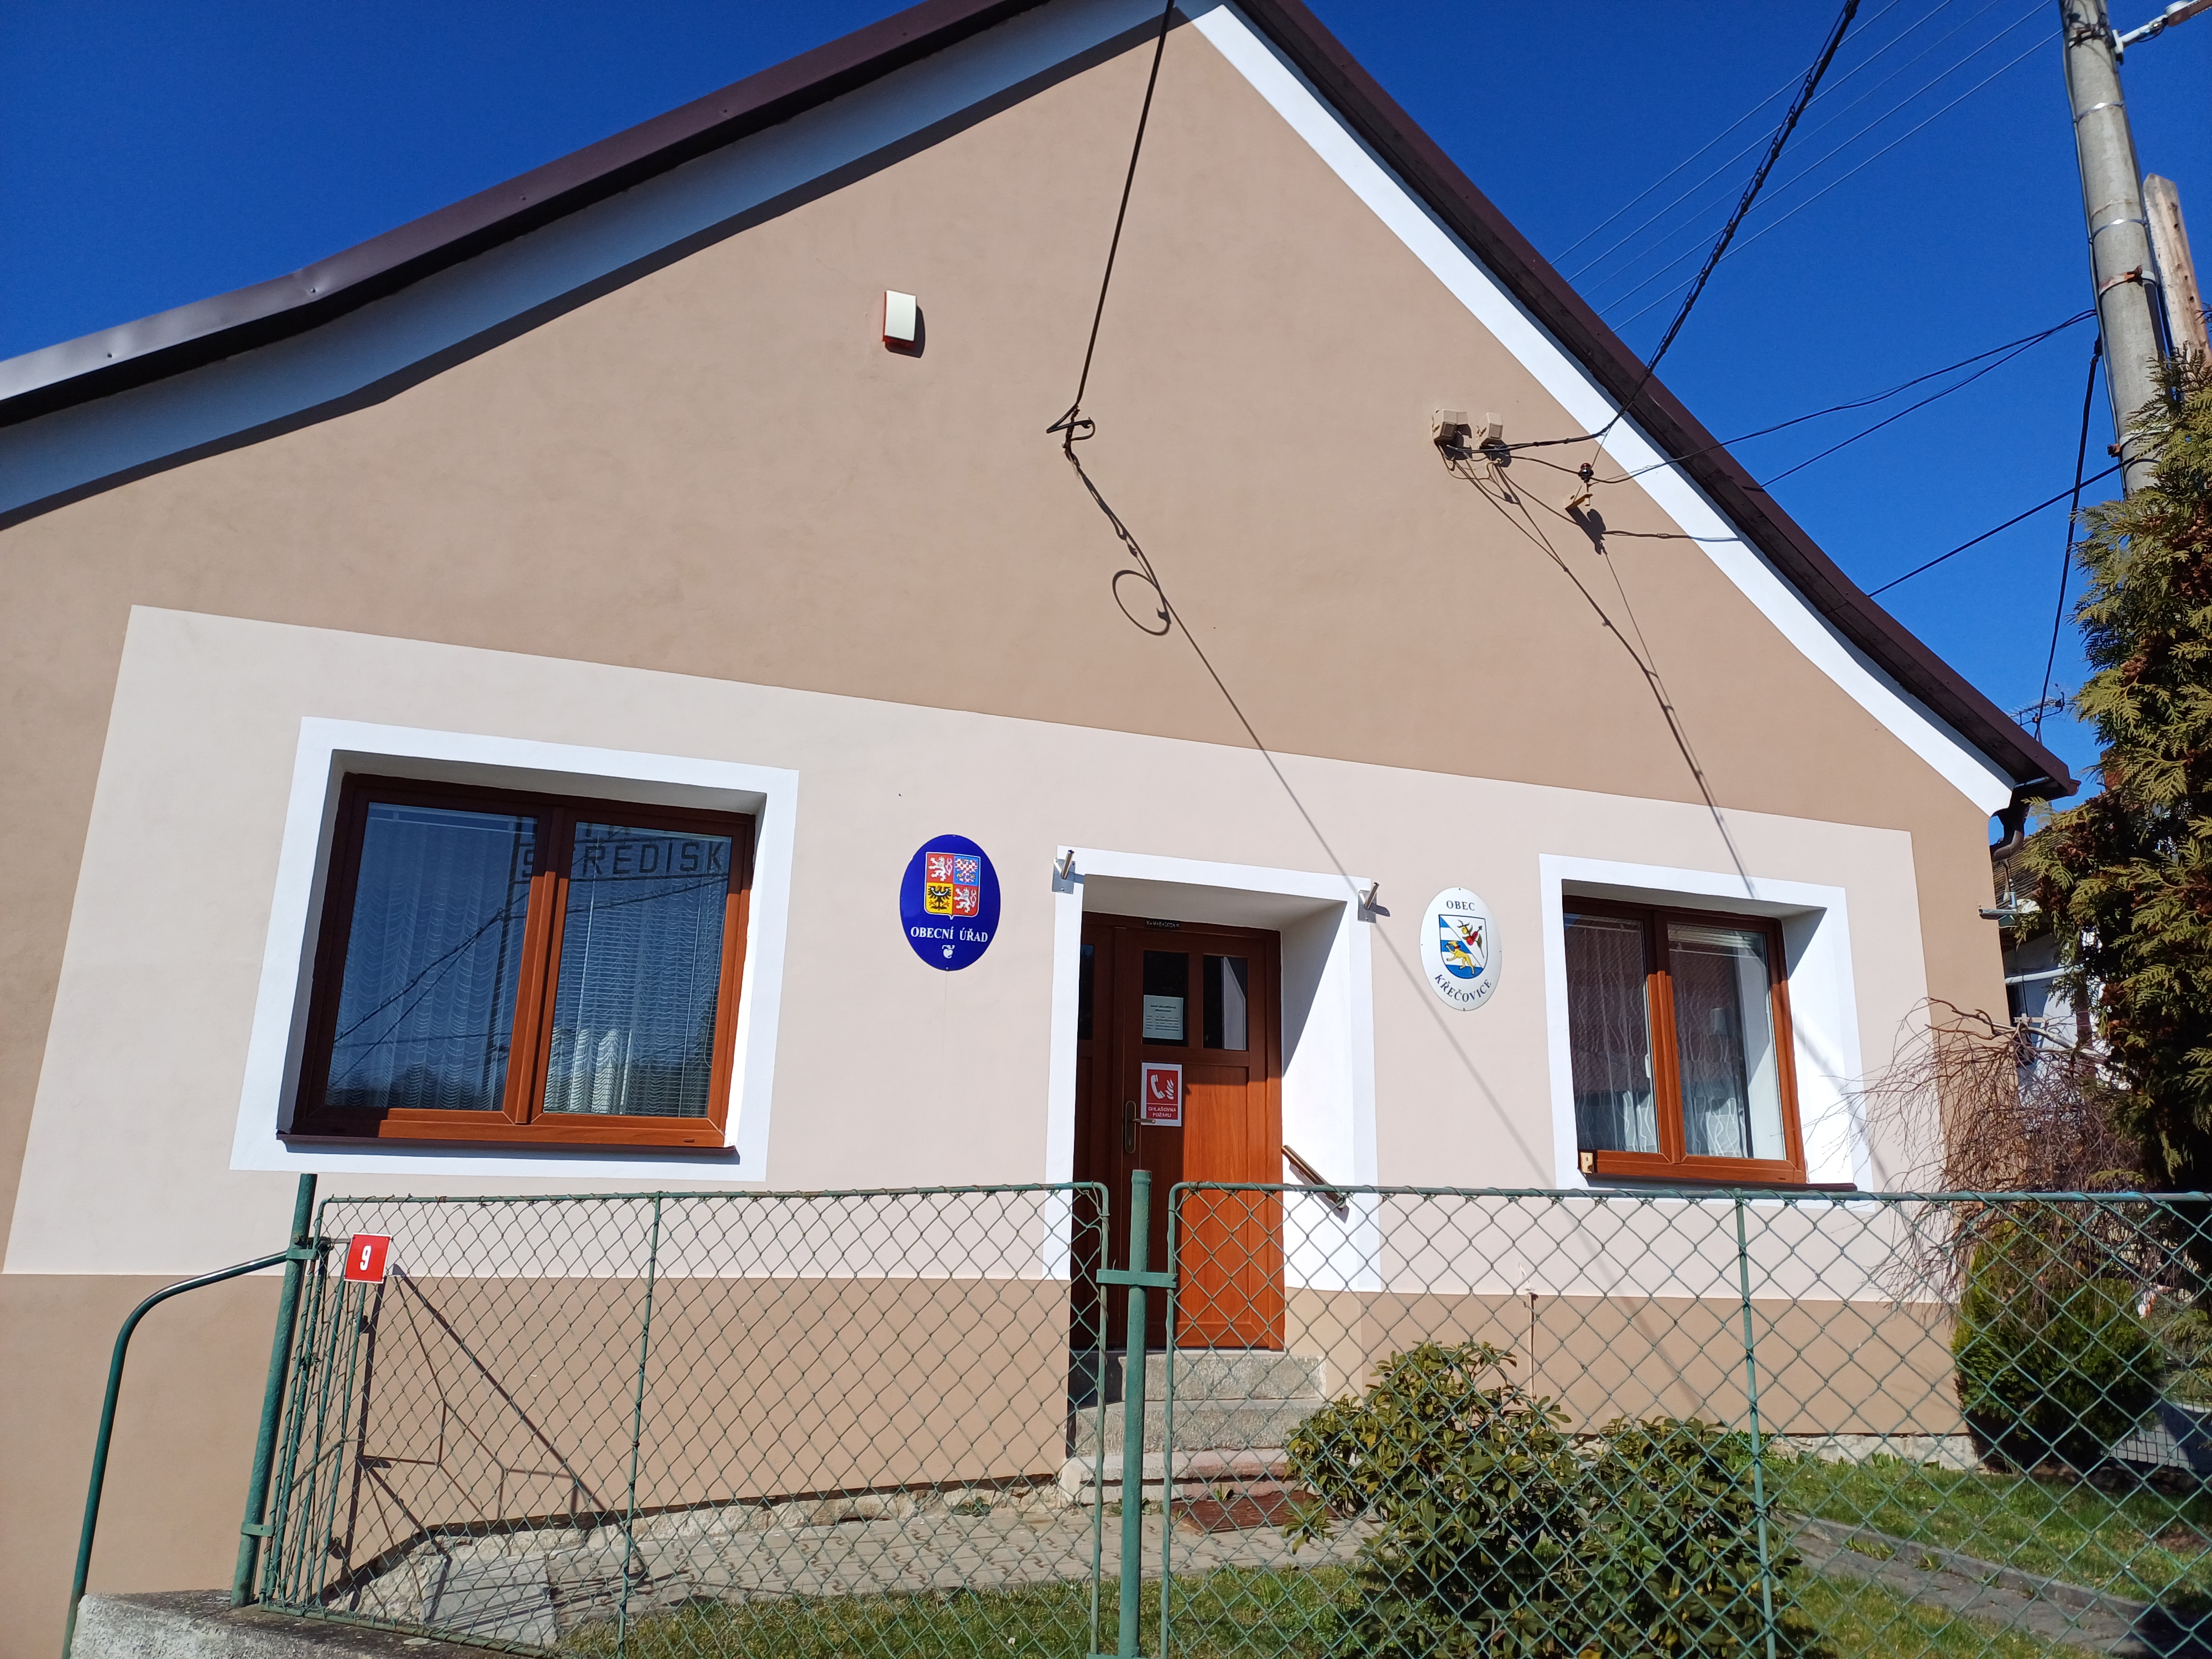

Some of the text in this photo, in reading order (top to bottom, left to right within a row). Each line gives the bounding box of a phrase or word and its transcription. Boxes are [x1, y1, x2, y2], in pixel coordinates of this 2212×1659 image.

[1447, 900, 1475, 911] OBEC
[910, 926, 988, 942] OBECNÍ ÚŘAD
[1434, 973, 1491, 1002] KŘEČOVICE
[359, 1245, 372, 1271] 9
